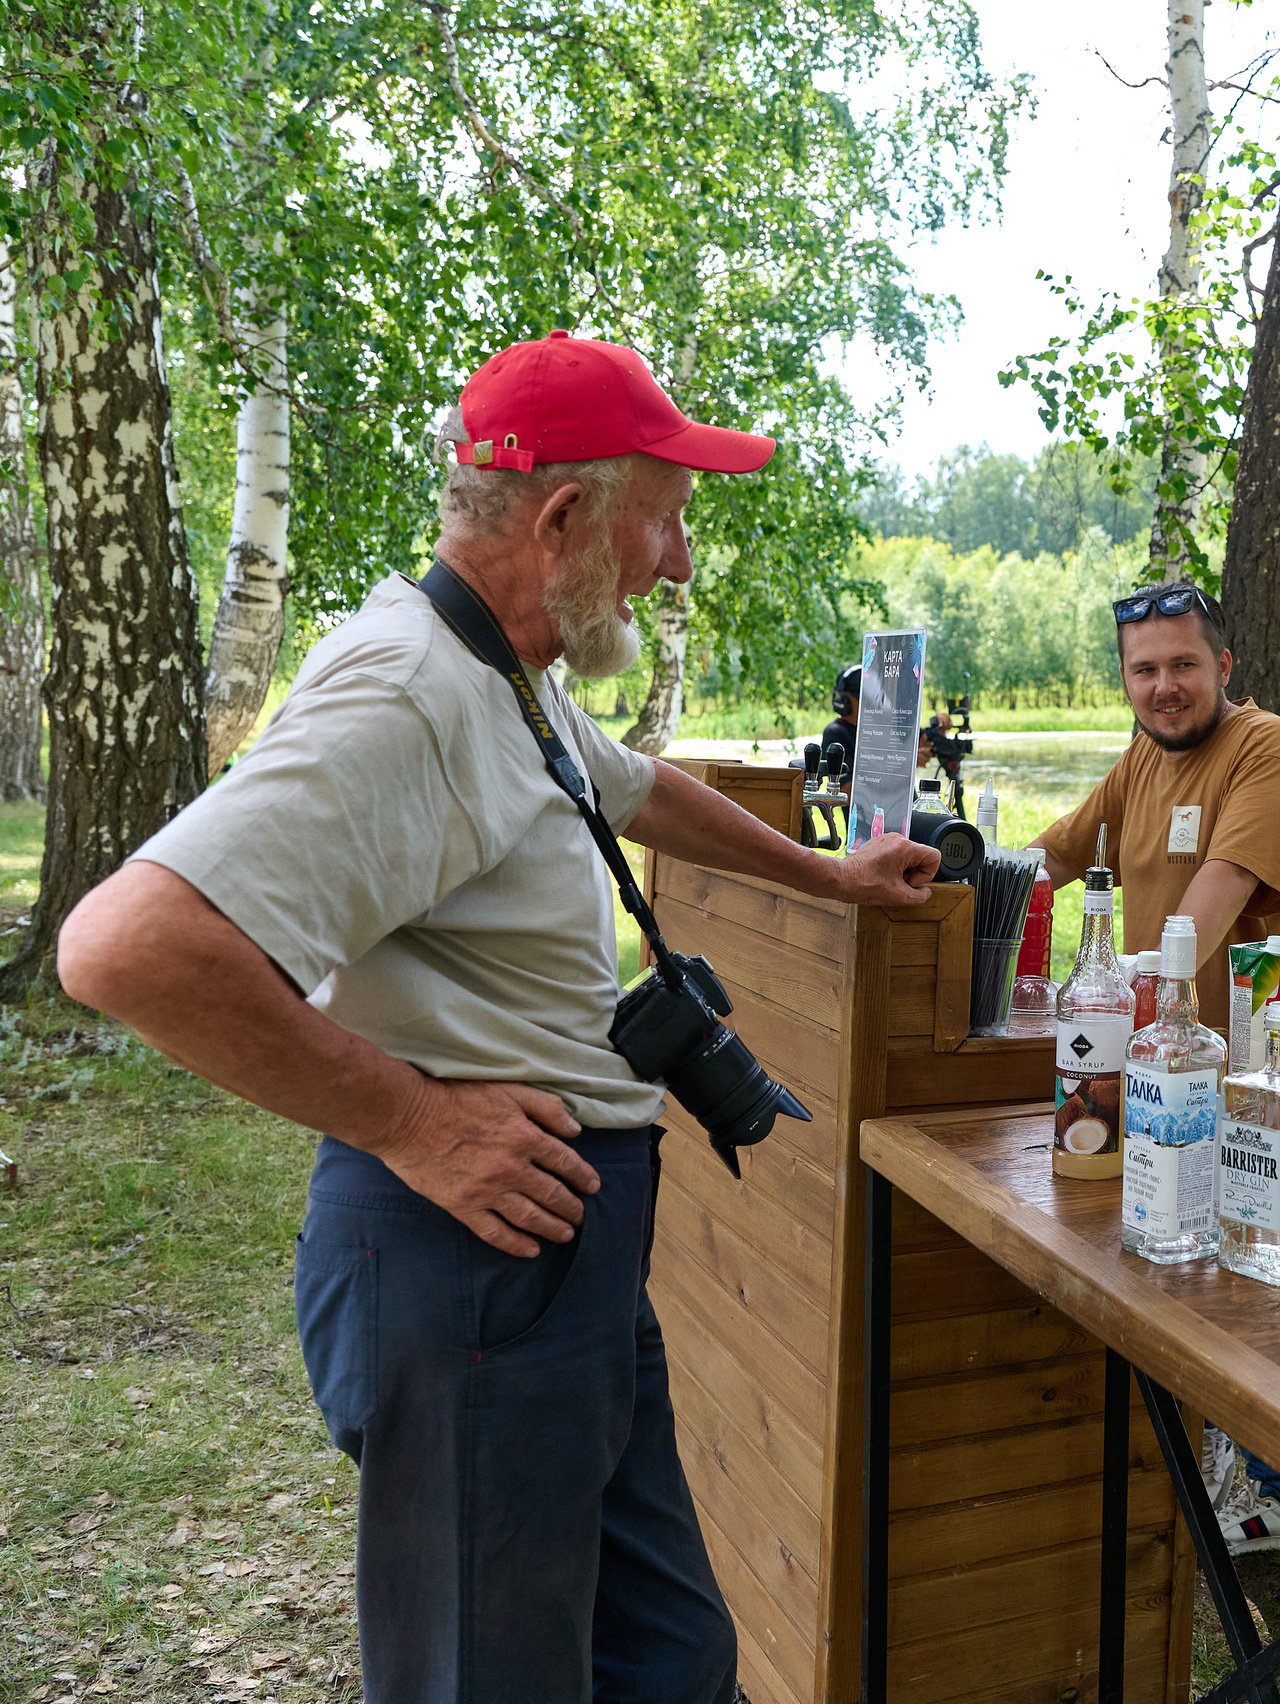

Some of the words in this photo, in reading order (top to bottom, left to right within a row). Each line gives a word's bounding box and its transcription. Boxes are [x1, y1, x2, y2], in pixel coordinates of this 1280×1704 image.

[883, 650, 903, 663] КАРТА
[884, 665, 900, 678] БАРА
[510, 673, 553, 738] Nikon
[946, 843, 967, 858] JBL
[1066, 1072, 1096, 1080] COCONUT
[1126, 1074, 1164, 1106] ТАЛКА
[1188, 1082, 1208, 1092] ТАЛКА
[1221, 1145, 1278, 1180] BARRISTER
[1226, 1169, 1248, 1184] DRY
[1250, 1175, 1270, 1190] GIN
